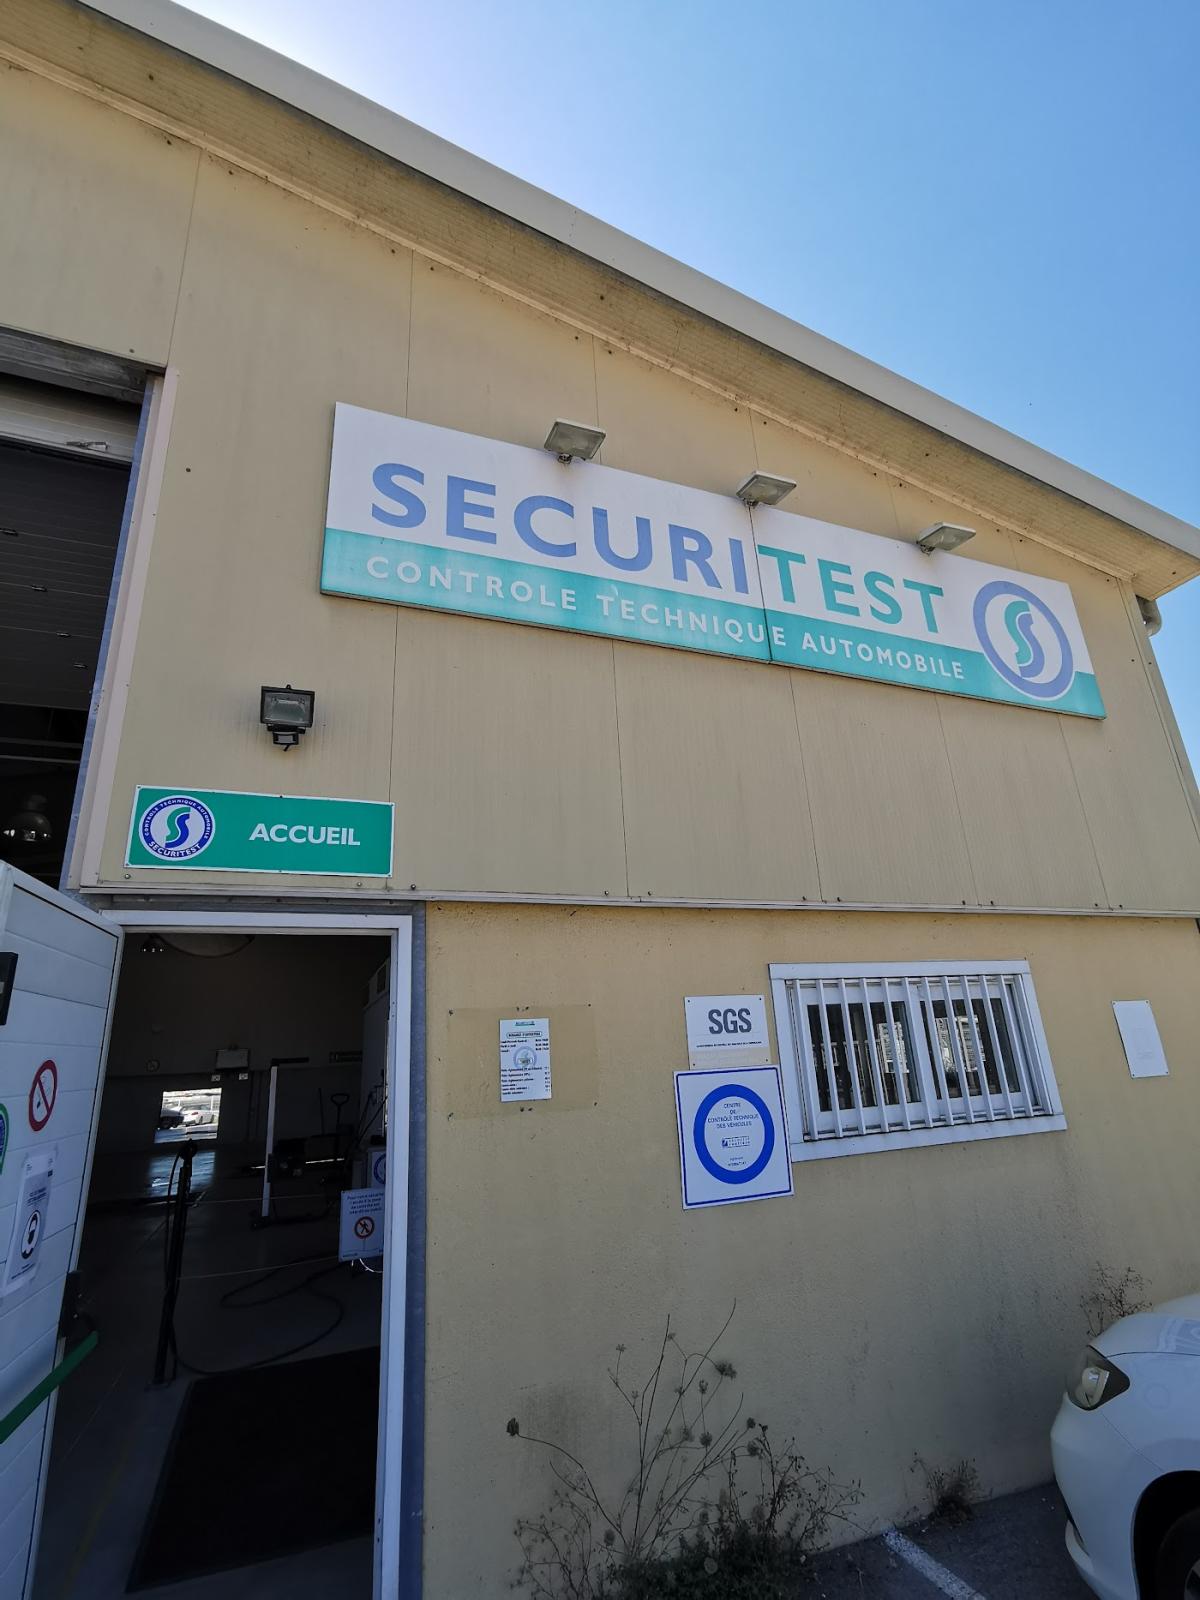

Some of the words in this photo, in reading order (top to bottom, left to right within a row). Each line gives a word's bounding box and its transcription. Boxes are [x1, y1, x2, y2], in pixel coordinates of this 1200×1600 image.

[371, 462, 944, 633] SECURITEST
[366, 556, 577, 611] CONTROLE
[596, 594, 786, 647] TECHNIQUE
[801, 631, 965, 680] AUTOMOBILE
[160, 798, 197, 808] TECHNIQUE
[248, 822, 361, 846] ACCUEIL
[148, 841, 201, 857] SECURITEST
[708, 1007, 752, 1034] SGS
